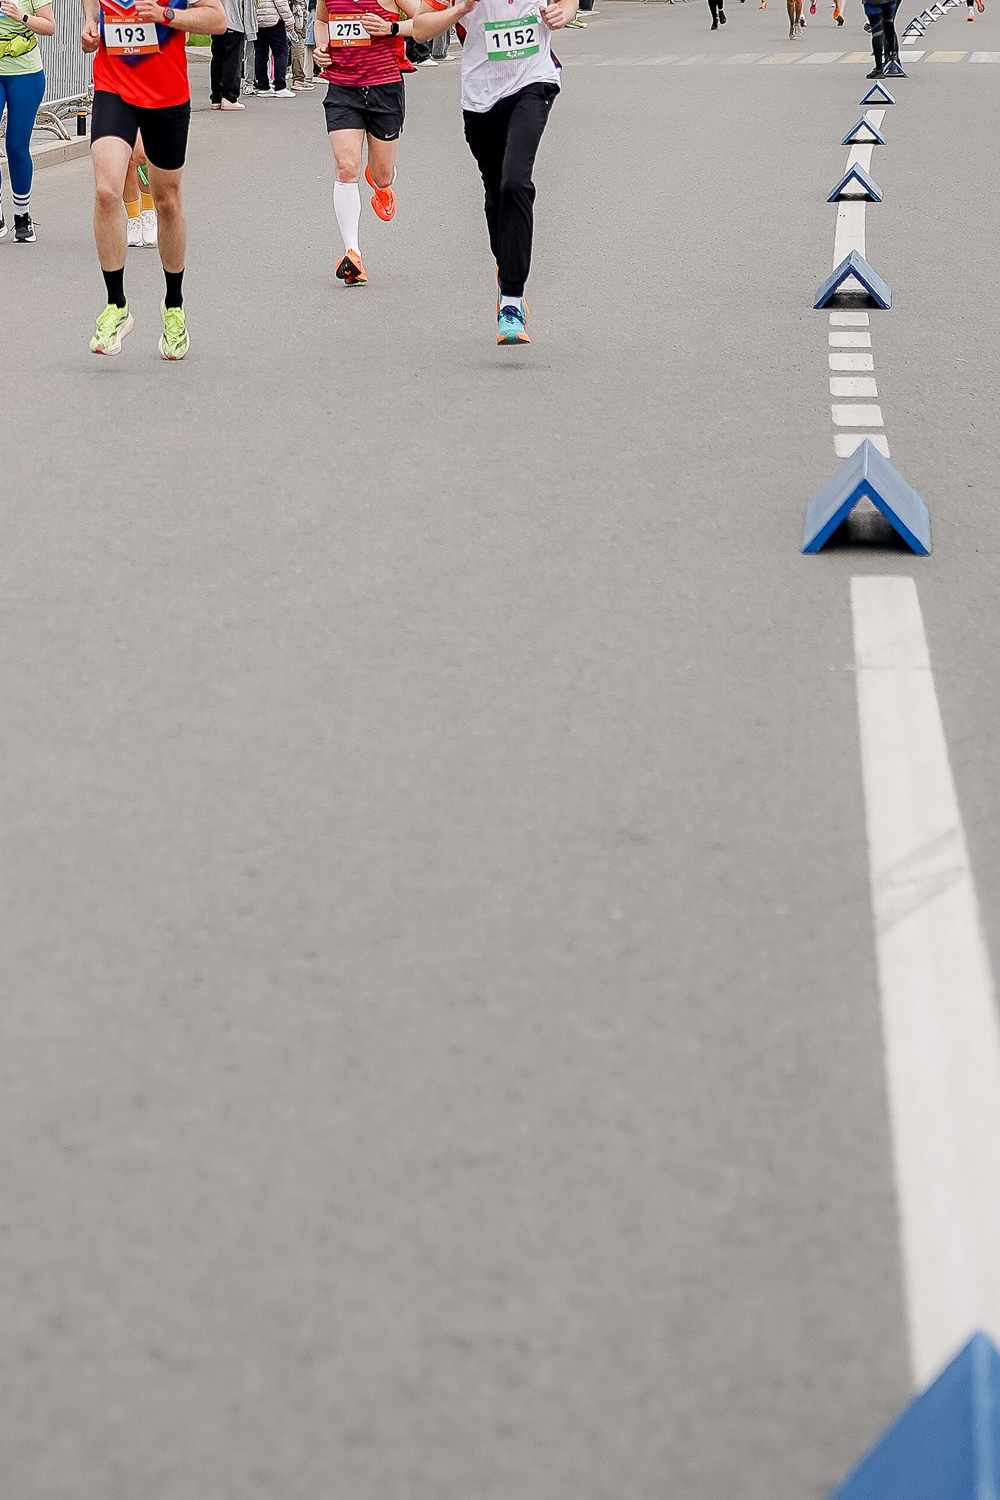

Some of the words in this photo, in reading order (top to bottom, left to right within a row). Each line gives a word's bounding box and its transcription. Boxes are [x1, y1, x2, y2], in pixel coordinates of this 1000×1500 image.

[115, 27, 146, 43] 193
[337, 24, 361, 36] 275
[492, 28, 535, 48] 1152
